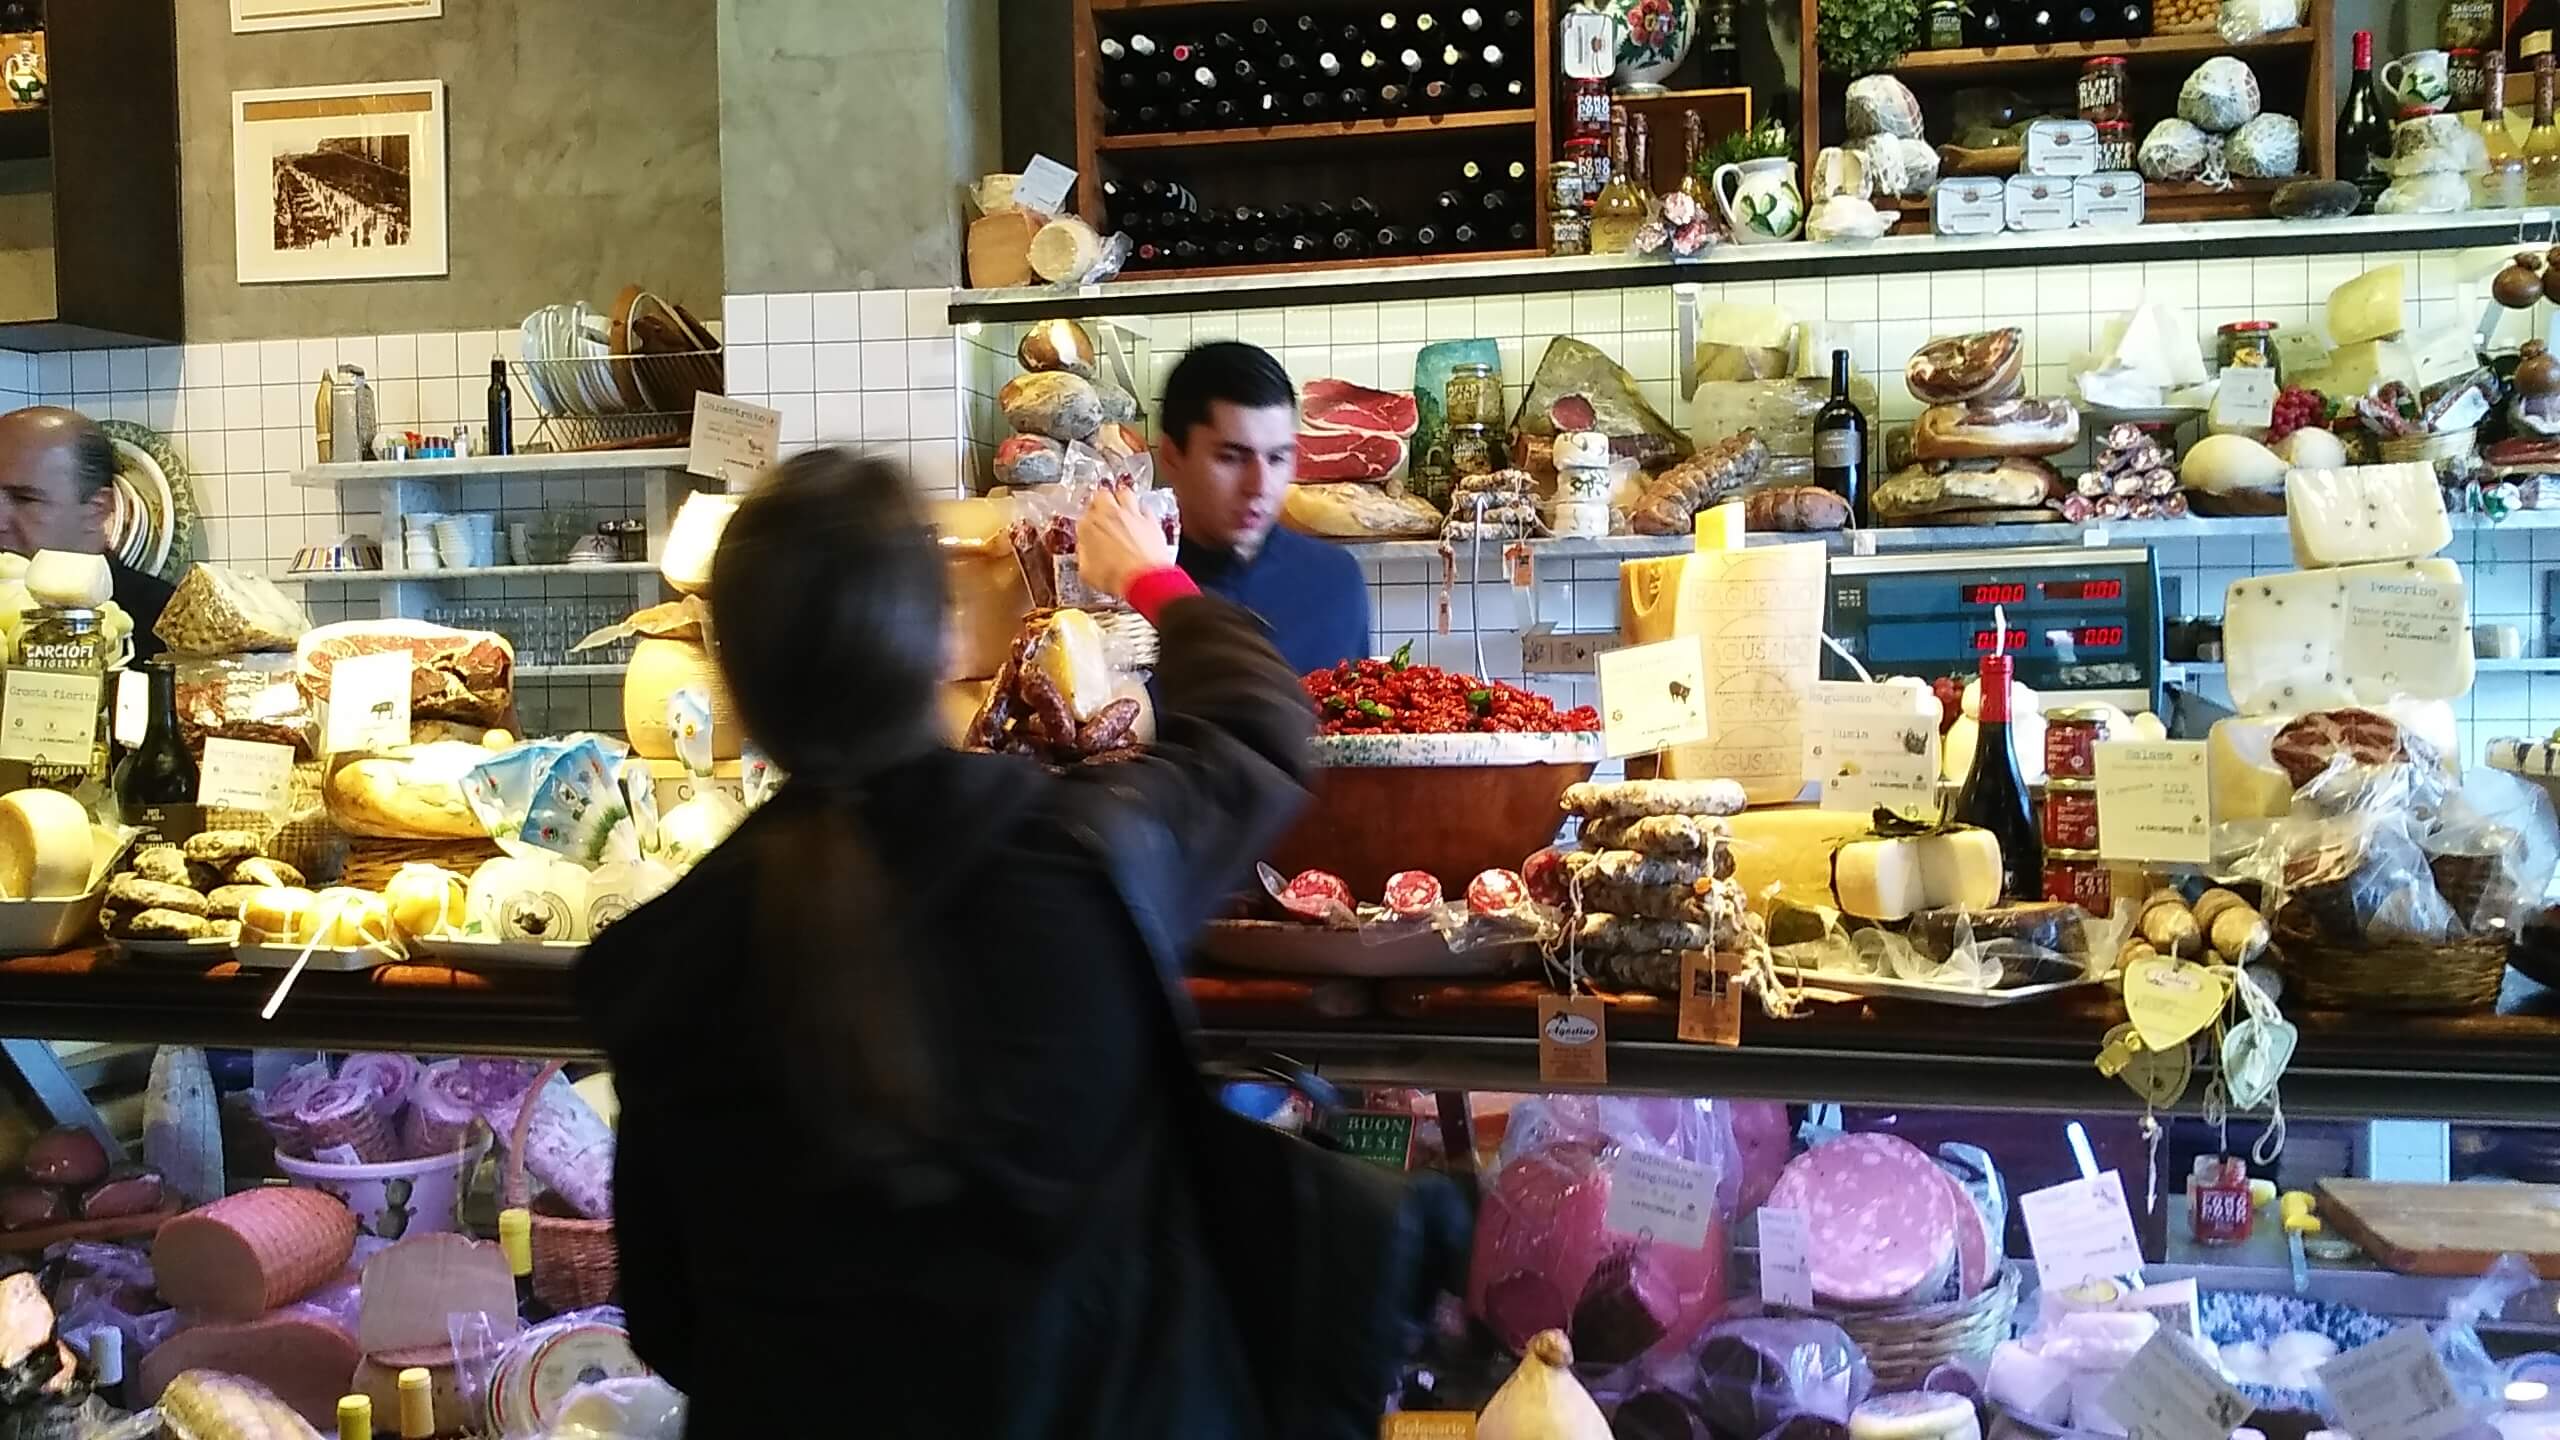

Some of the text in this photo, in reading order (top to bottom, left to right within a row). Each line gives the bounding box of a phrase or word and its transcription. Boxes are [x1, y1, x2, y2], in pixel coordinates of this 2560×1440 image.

[2079, 77, 2117, 91] OLIVE
[26, 644, 94, 659] CARCIOFI
[1348, 1116, 1406, 1132] BUON
